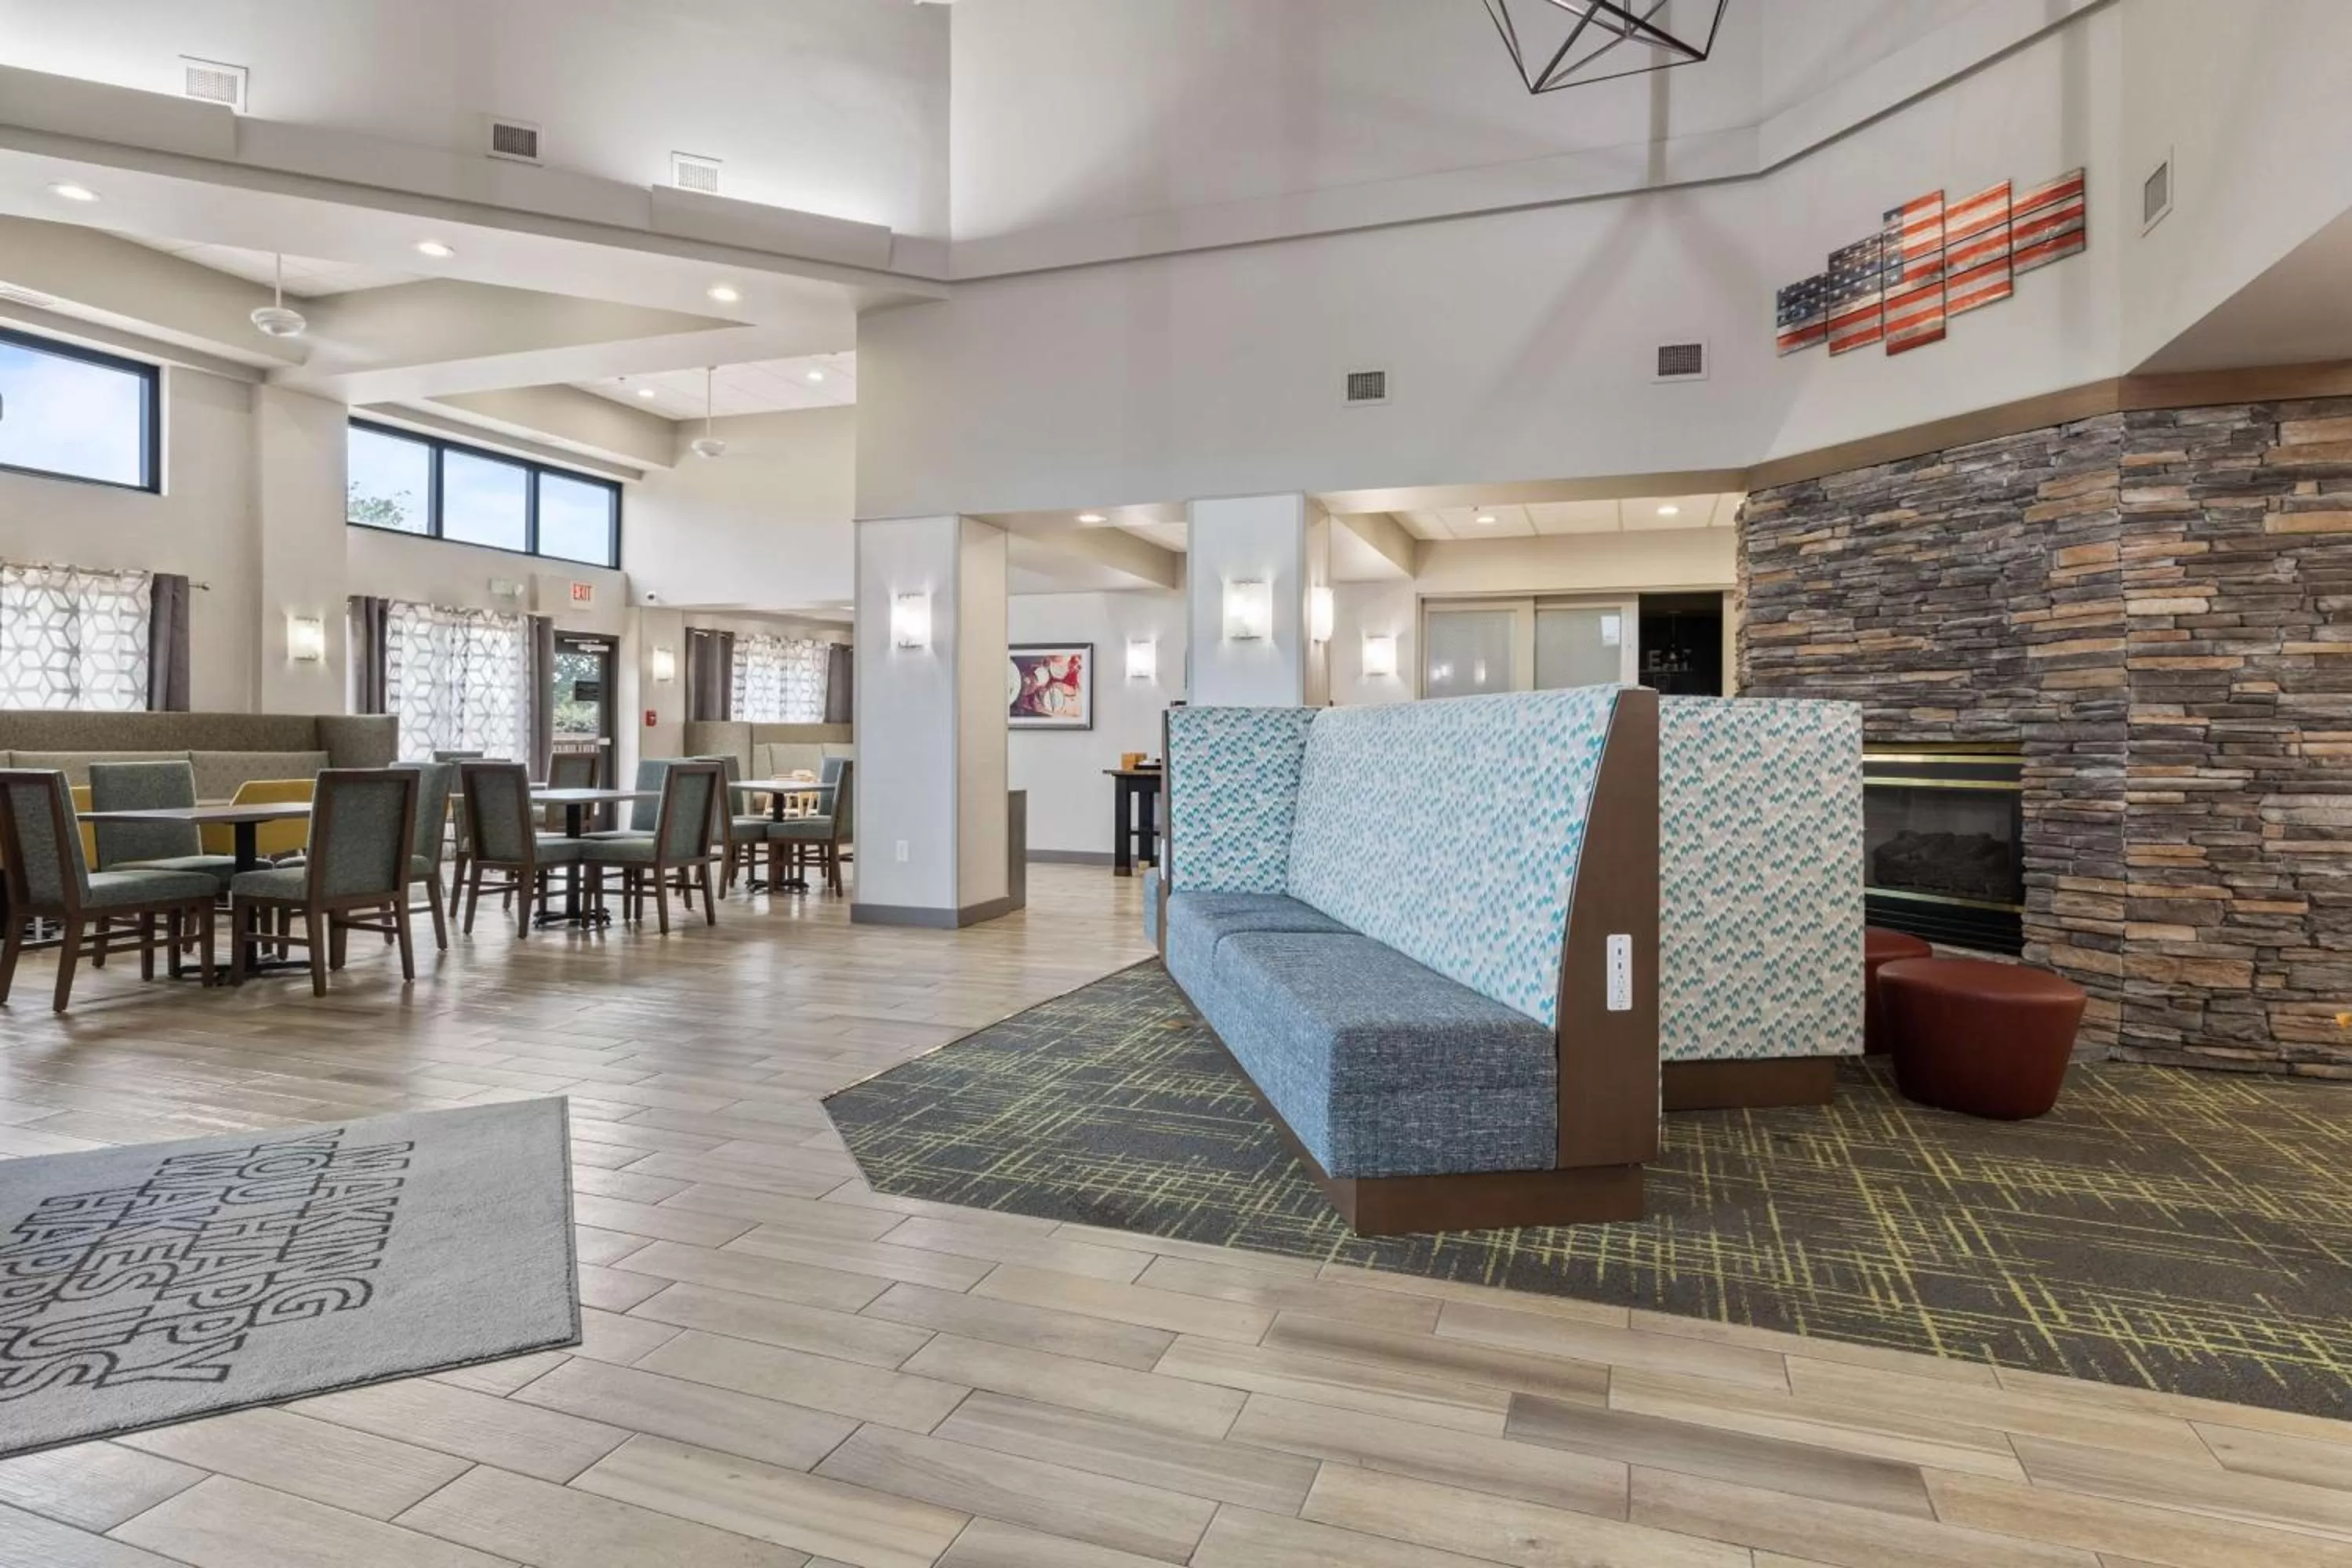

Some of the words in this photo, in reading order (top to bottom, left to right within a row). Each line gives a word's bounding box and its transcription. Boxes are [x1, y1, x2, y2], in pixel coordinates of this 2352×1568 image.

[573, 583, 593, 602] EXIT
[53, 1149, 259, 1301] MAKES
[219, 1128, 346, 1204] YOU
[91, 1200, 313, 1390] HAPPY
[246, 1141, 415, 1327] MAKING
[0, 1304, 157, 1402] US
